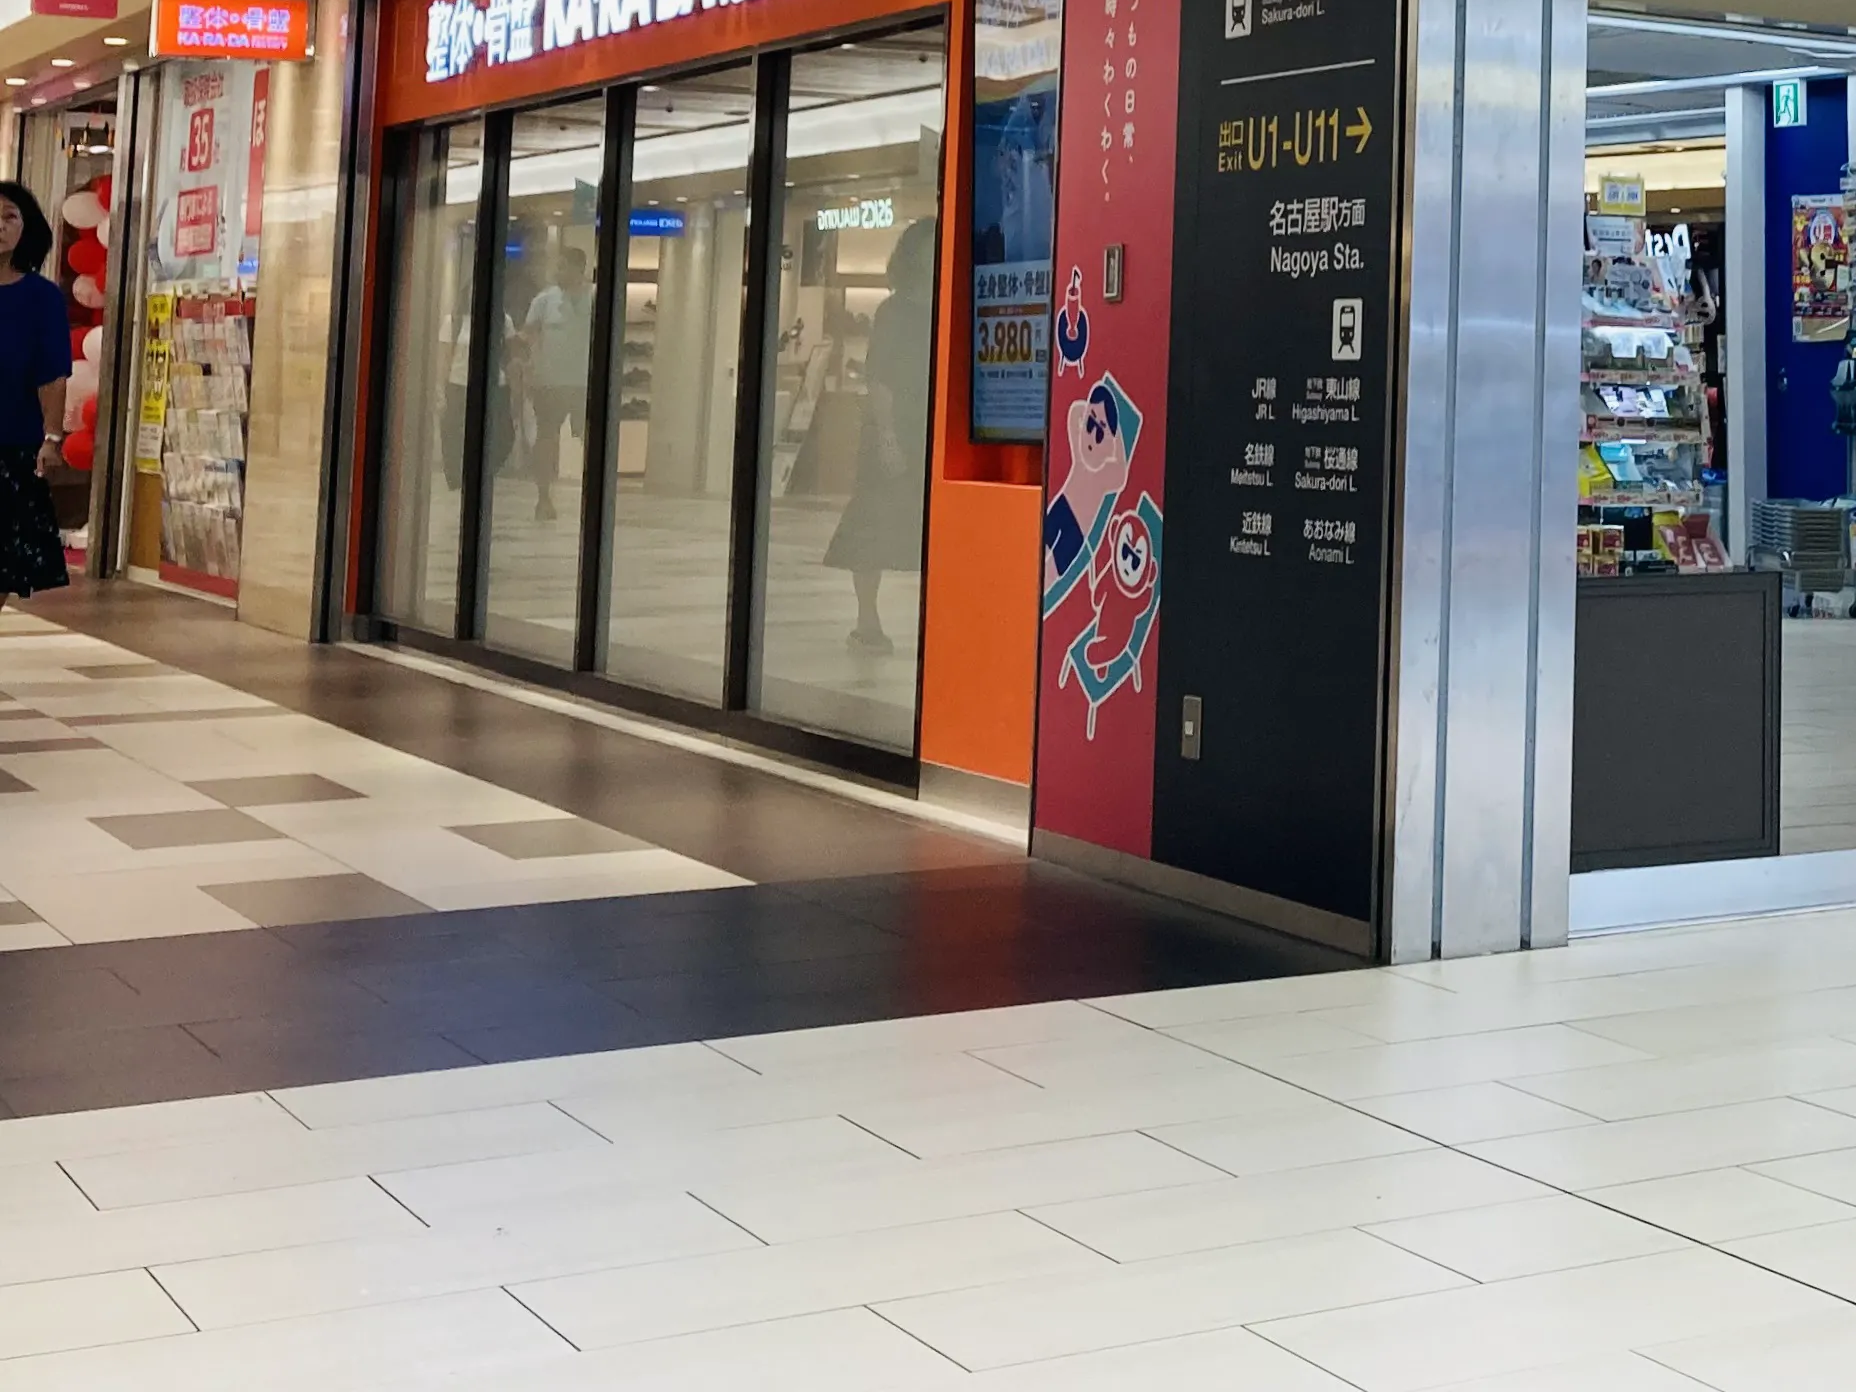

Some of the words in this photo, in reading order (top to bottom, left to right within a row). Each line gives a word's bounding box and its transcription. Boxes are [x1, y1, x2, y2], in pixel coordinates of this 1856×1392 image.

[1261, 1, 1314, 25] Sakura-dori
[1219, 120, 1244, 148] 出口
[1248, 107, 1339, 170] U1-U11
[1218, 150, 1242, 172] Exit
[1269, 196, 1366, 236] 名古屋駅方面
[1270, 245, 1329, 279] Nagoya
[1333, 241, 1365, 270] Sta.
[1251, 377, 1277, 401] JR線
[1325, 376, 1361, 402] 東山線
[1255, 403, 1267, 420] JR
[1292, 403, 1349, 425] Higashiyama
[1244, 442, 1275, 467] 名鉄線
[1324, 445, 1359, 471] 桜通線
[1294, 471, 1347, 491] Sakura-dori
[1303, 518, 1356, 544] あおなみ線
[1308, 543, 1344, 563] Aonami
